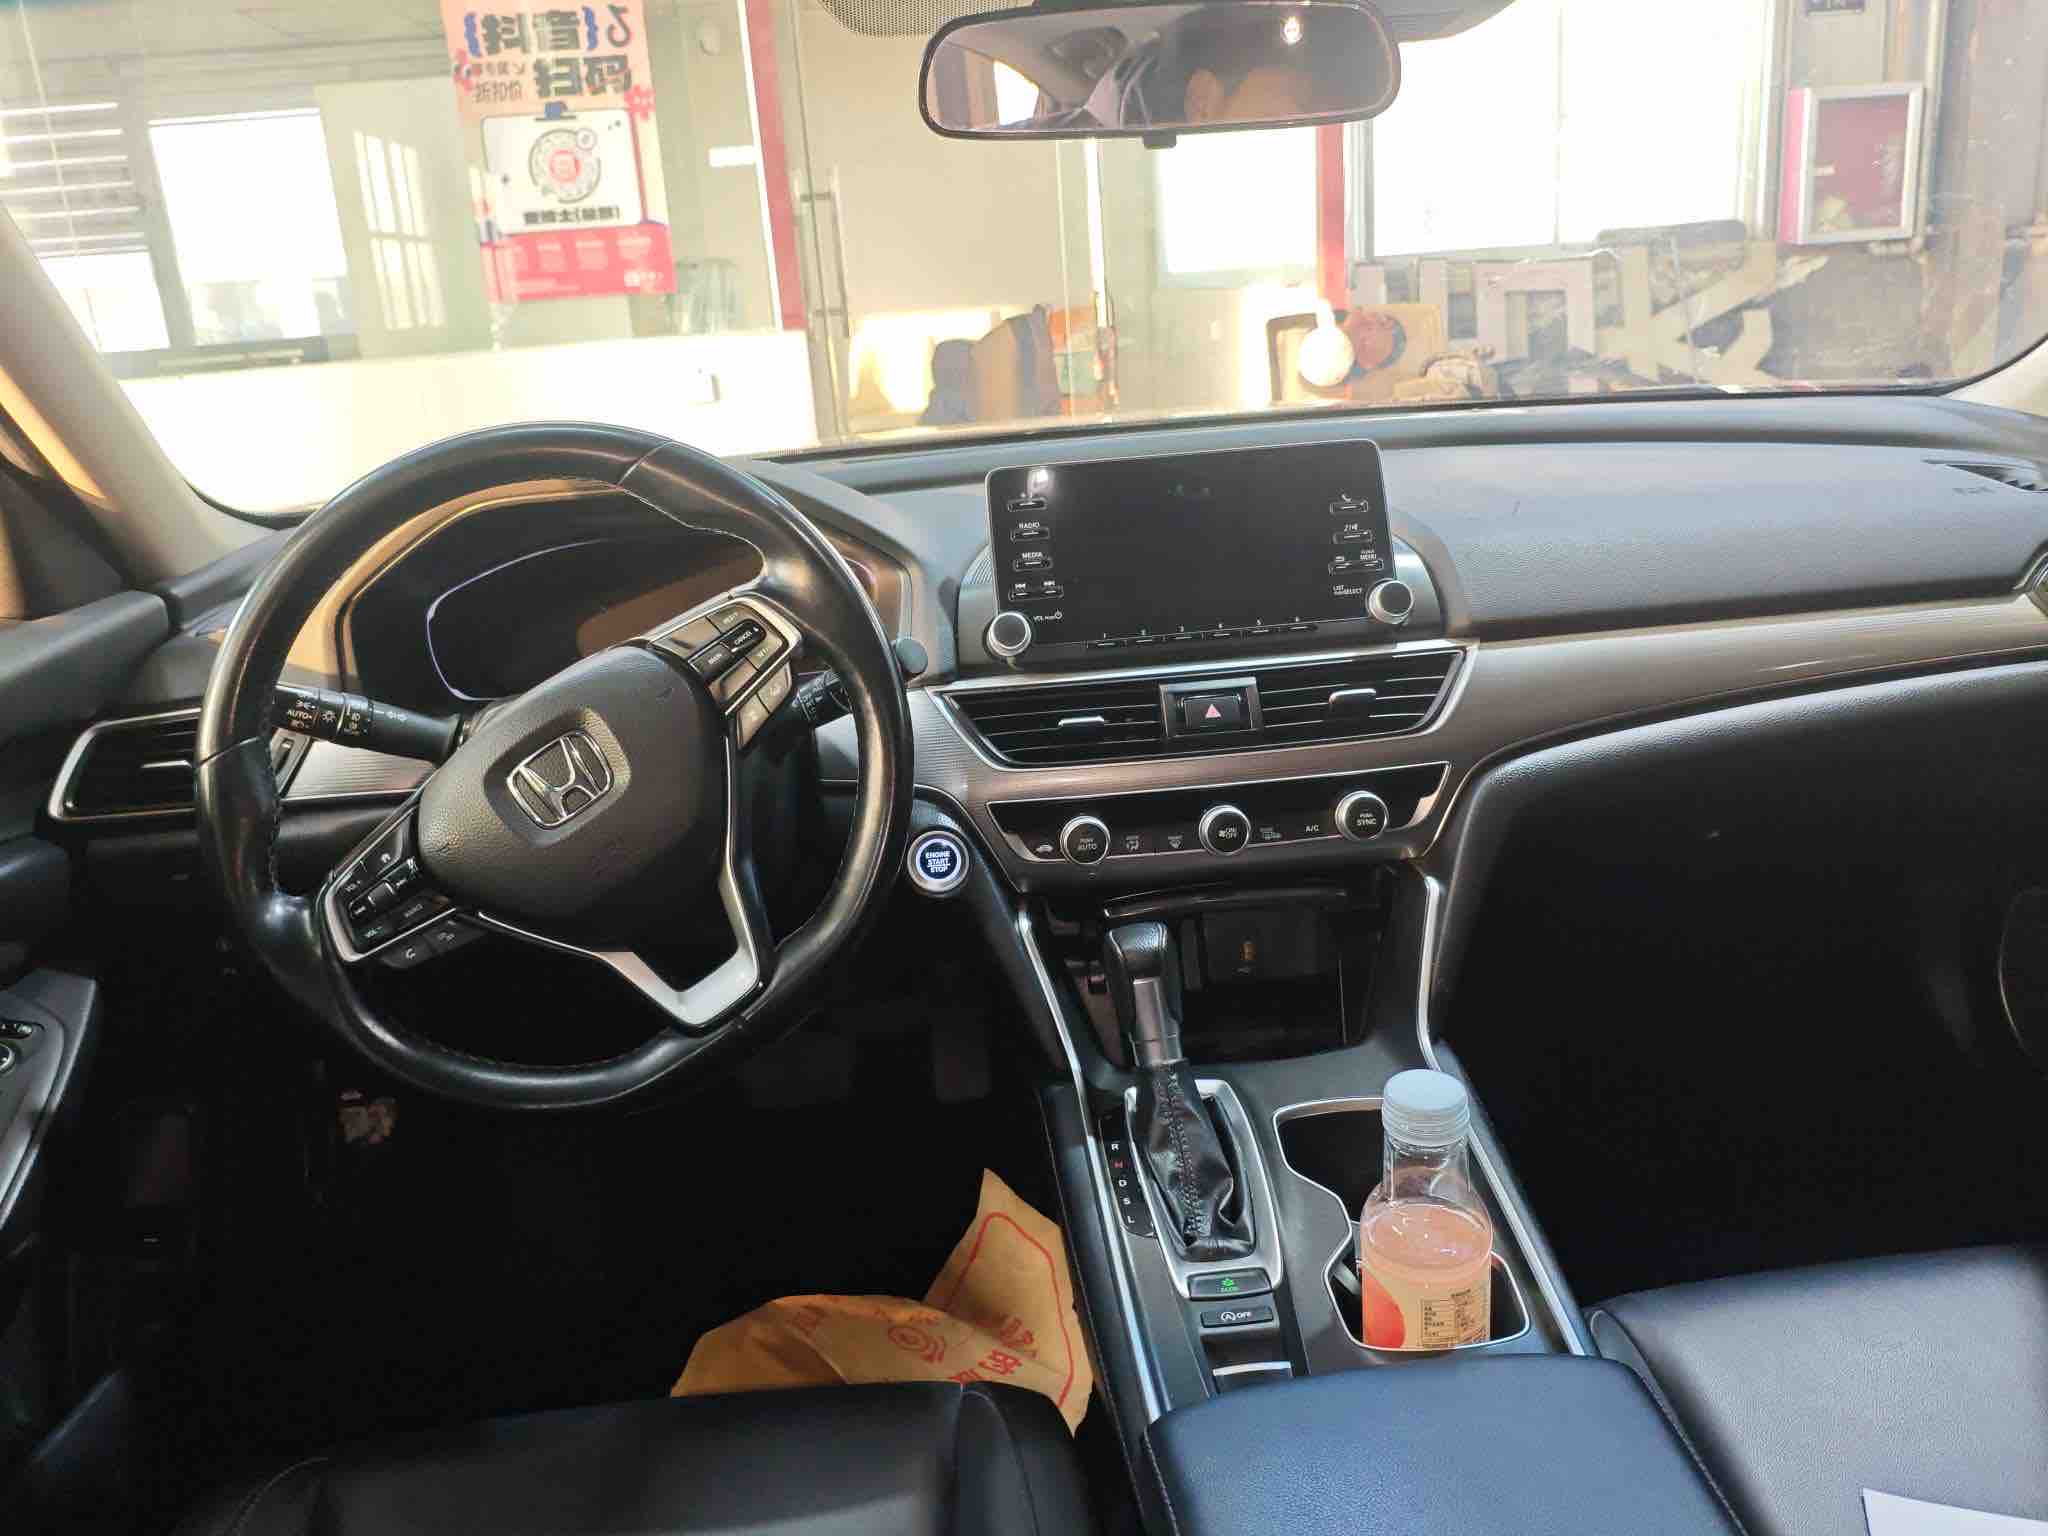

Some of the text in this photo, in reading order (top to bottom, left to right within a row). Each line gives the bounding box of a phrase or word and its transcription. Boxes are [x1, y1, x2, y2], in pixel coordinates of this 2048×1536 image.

[1018, 521, 1041, 529] RADIO
[1021, 551, 1043, 560] MEDIA
[1356, 818, 1377, 826] SYNC
[1305, 824, 1320, 832] A/C
[1078, 842, 1097, 850] AUTO
[925, 850, 951, 859] ENGINE
[927, 857, 950, 867] START
[1111, 1143, 1119, 1151] R
[1123, 1197, 1131, 1205] S
[1127, 1215, 1136, 1224] L
